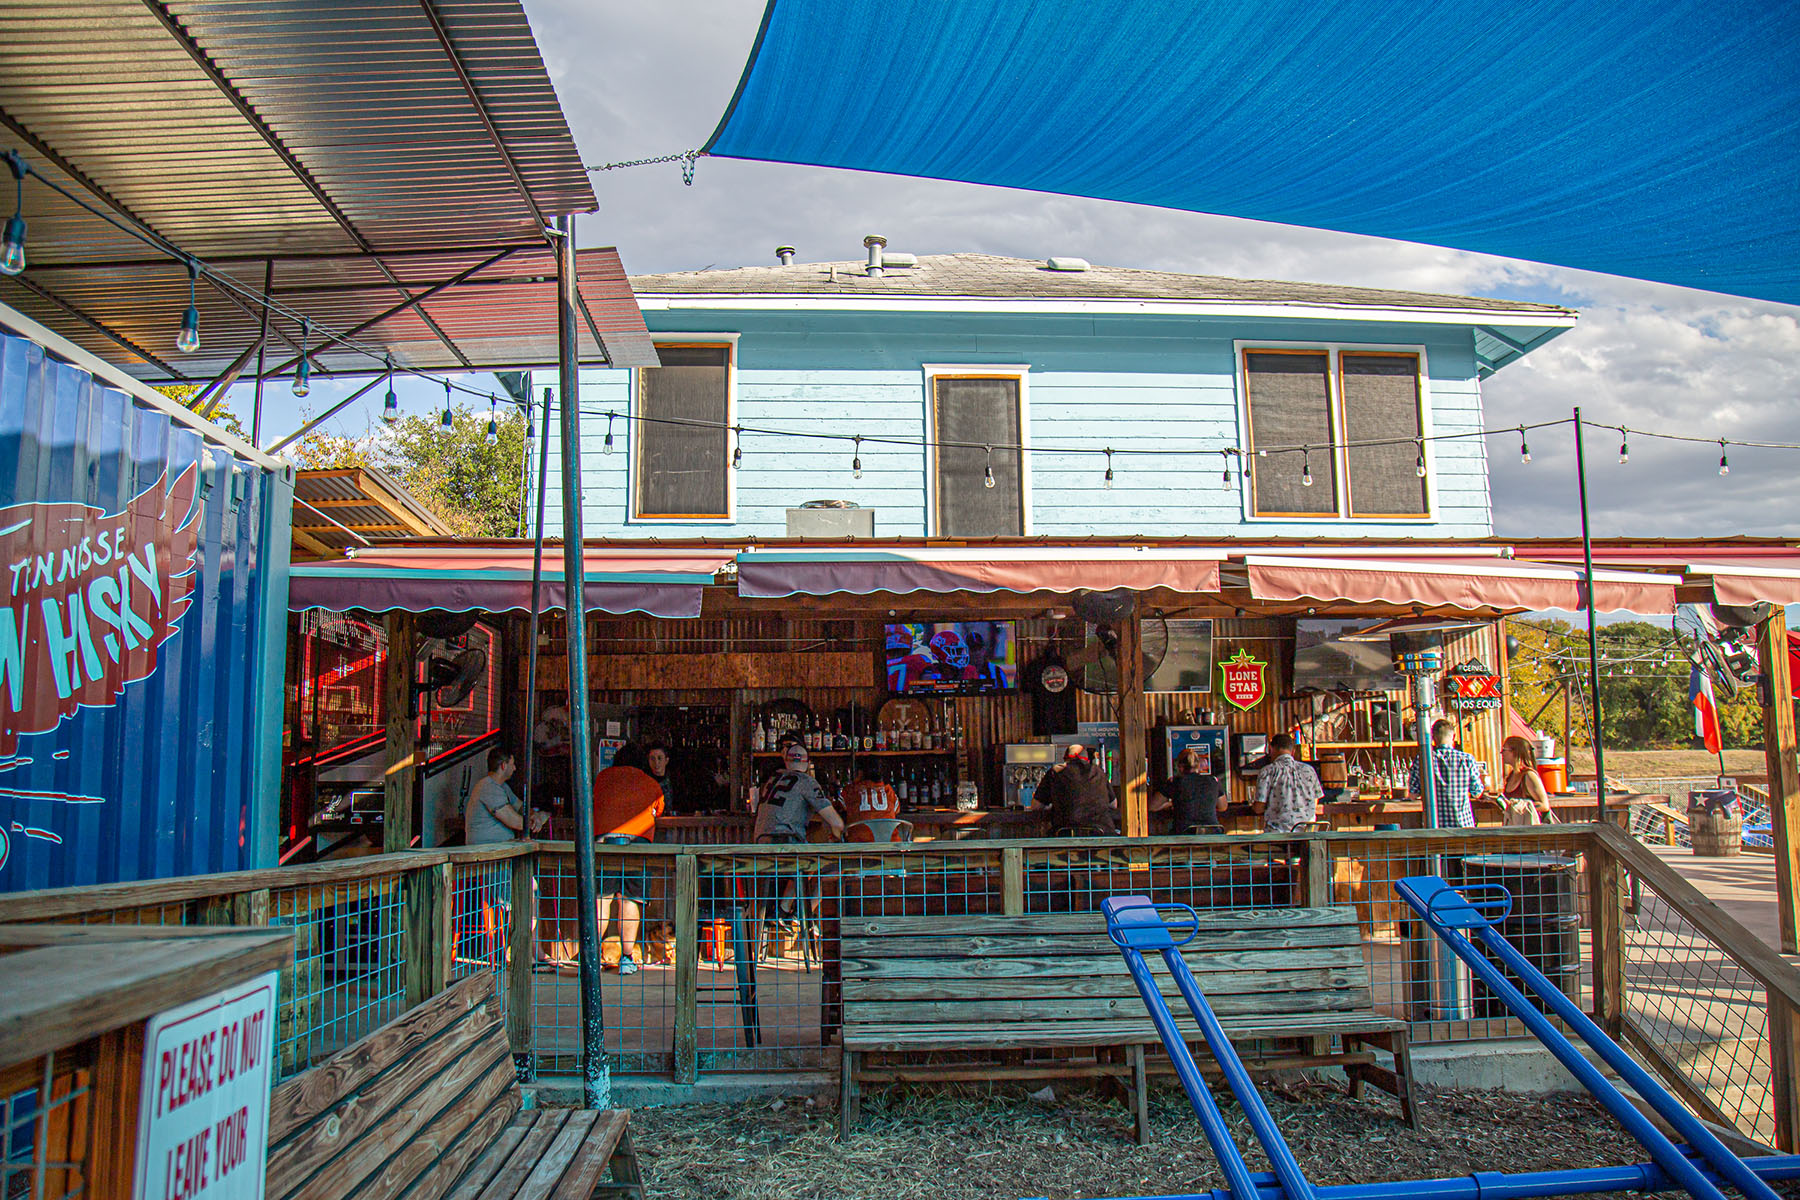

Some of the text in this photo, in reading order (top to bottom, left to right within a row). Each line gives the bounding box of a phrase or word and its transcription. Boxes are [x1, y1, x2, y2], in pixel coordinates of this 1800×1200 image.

[1229, 671, 1258, 681] LONE
[1229, 682, 1258, 692] STAR
[1451, 698, 1503, 709] DOS EQUIS
[859, 786, 888, 812] 10
[157, 1008, 265, 1120] PLEASE DO NOT
[164, 1105, 249, 1200] LEAVE YOUR
